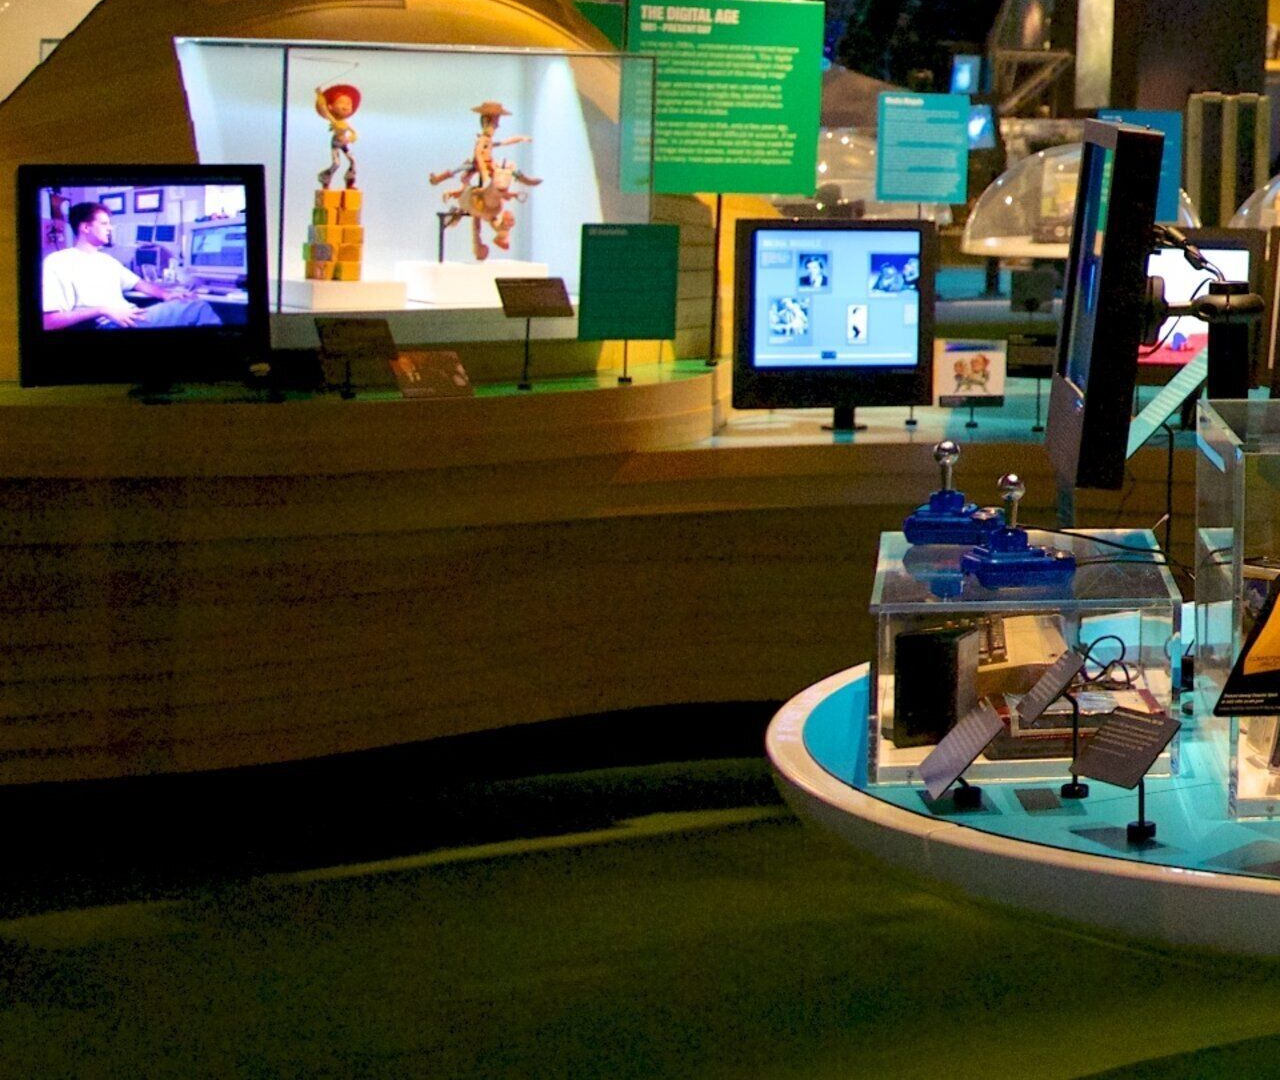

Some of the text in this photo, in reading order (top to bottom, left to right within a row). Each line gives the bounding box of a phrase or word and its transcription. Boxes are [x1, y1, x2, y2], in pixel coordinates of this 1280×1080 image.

[640, 5, 740, 25] THE DIGITAL AGE
